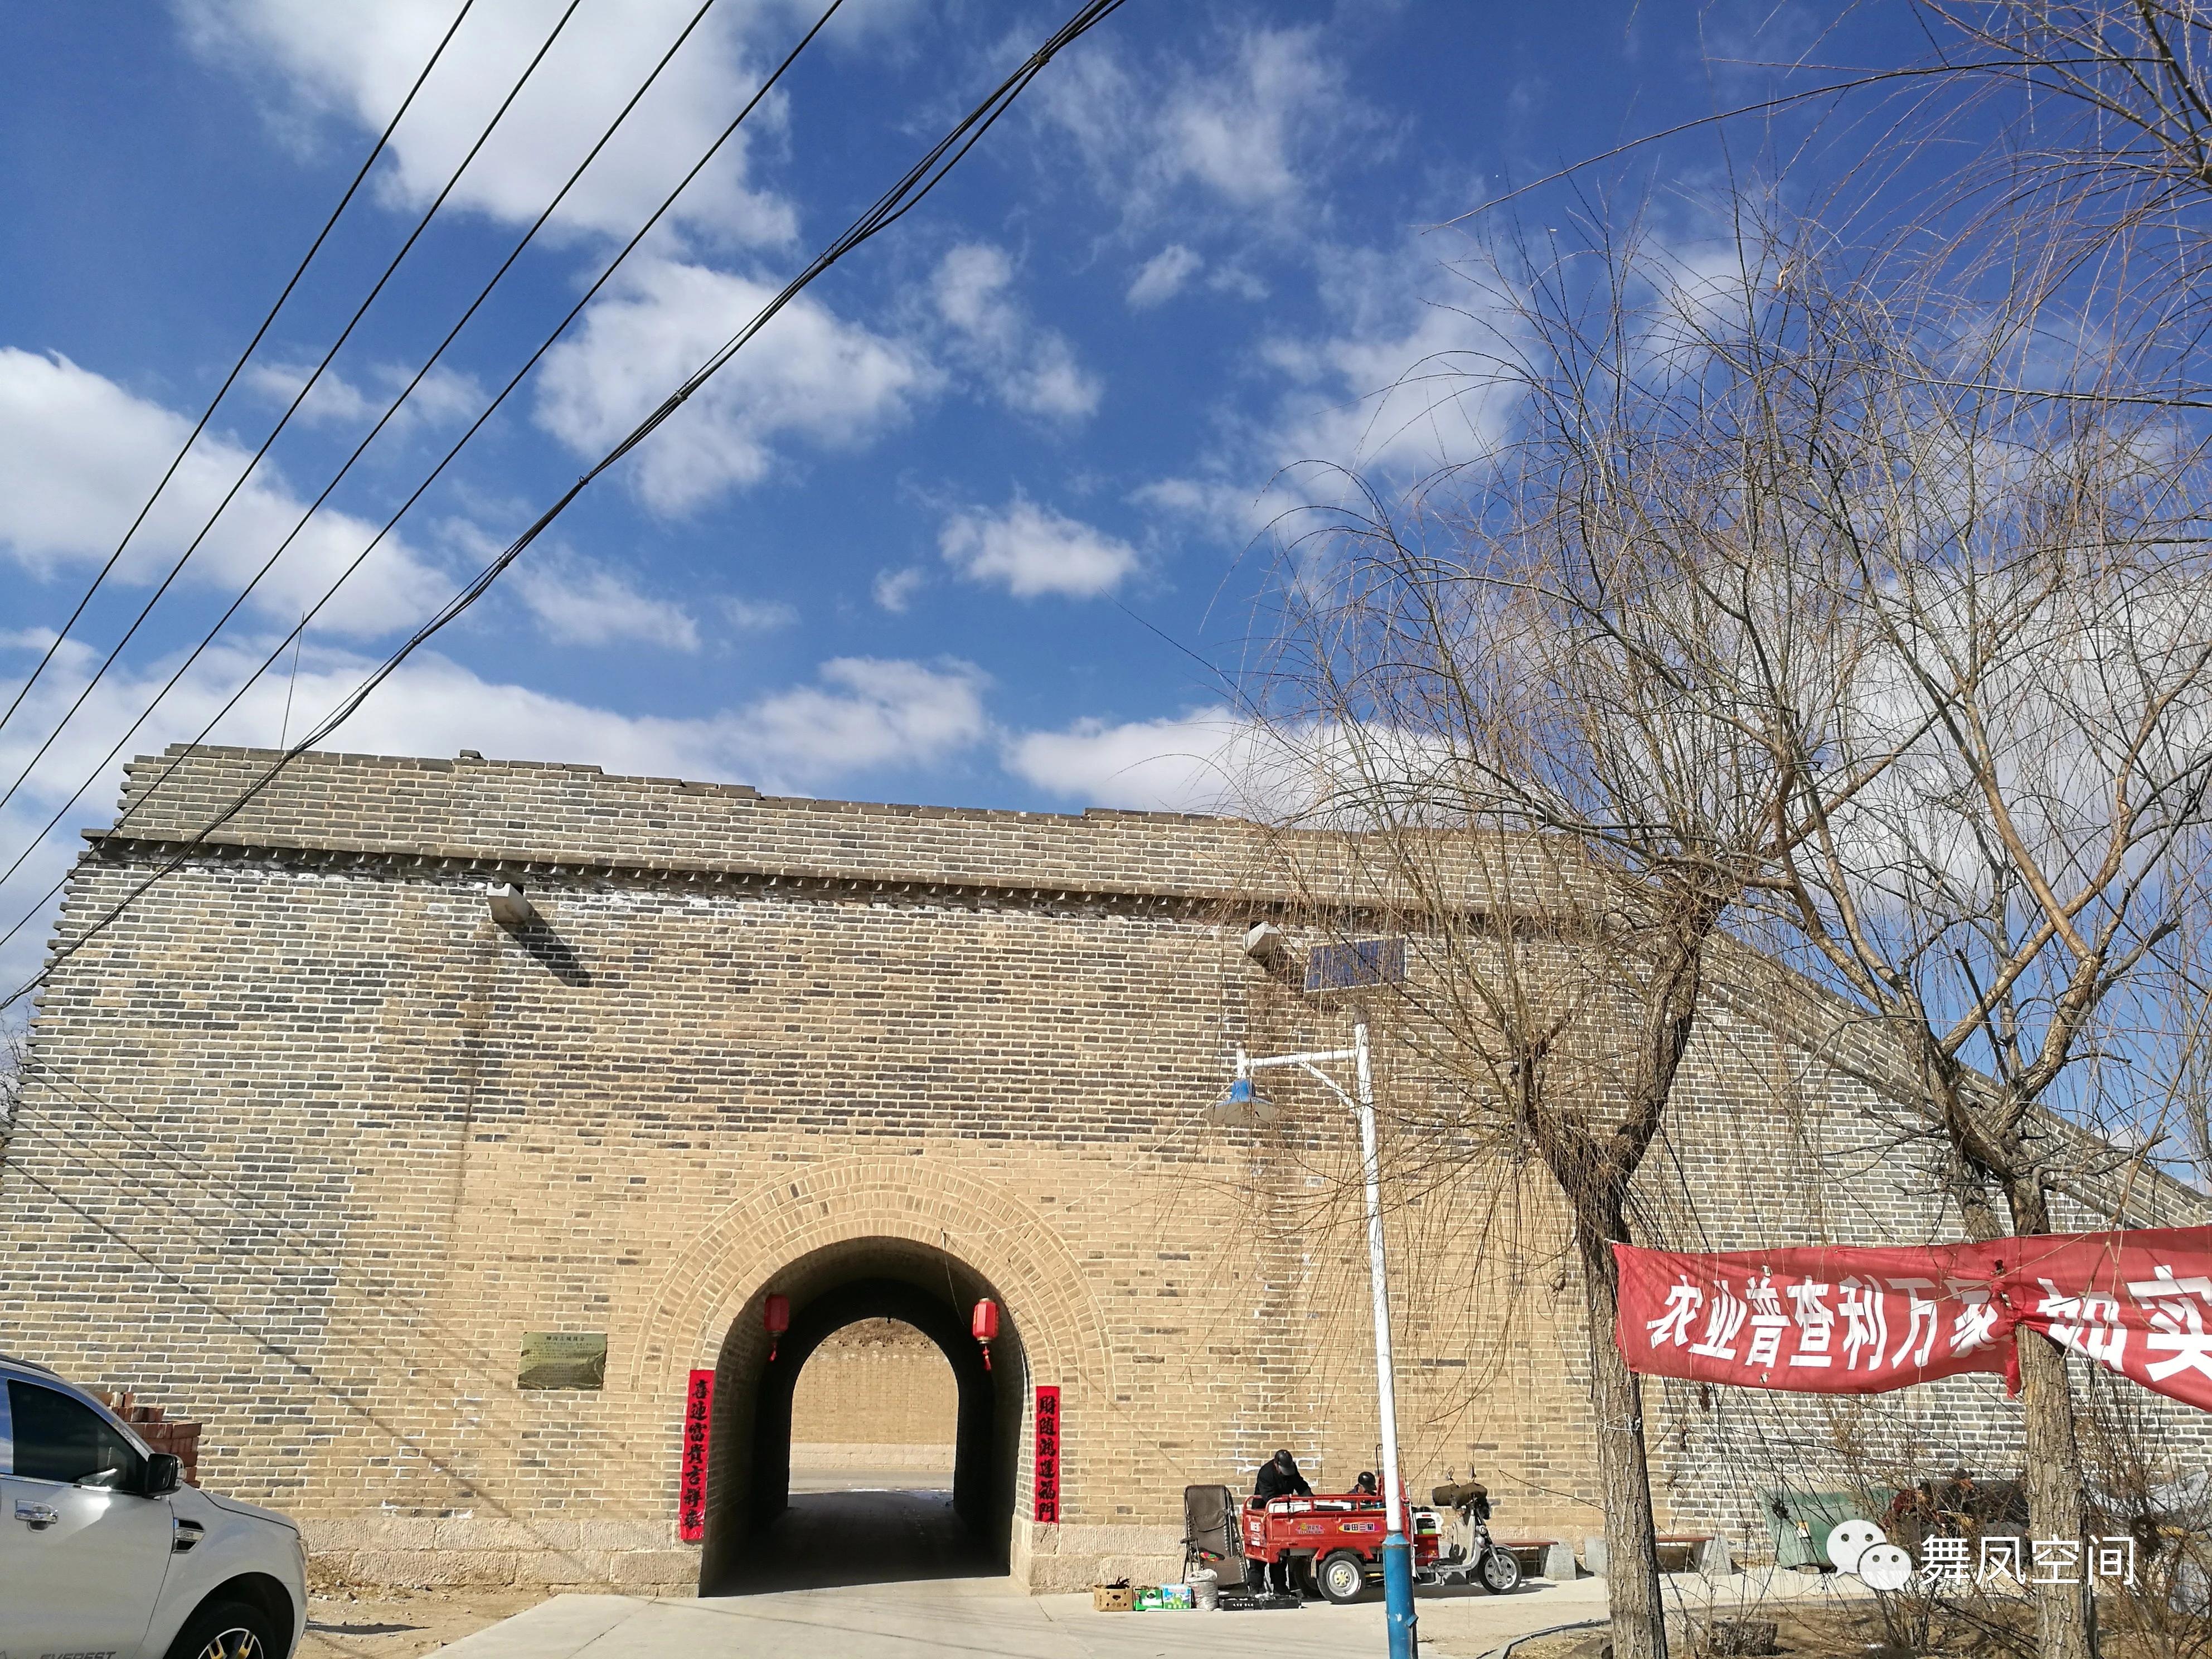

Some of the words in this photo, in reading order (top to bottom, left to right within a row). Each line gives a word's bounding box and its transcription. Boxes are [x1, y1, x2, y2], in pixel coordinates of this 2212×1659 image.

[1646, 1274, 1998, 1372] 农业普查利万家
